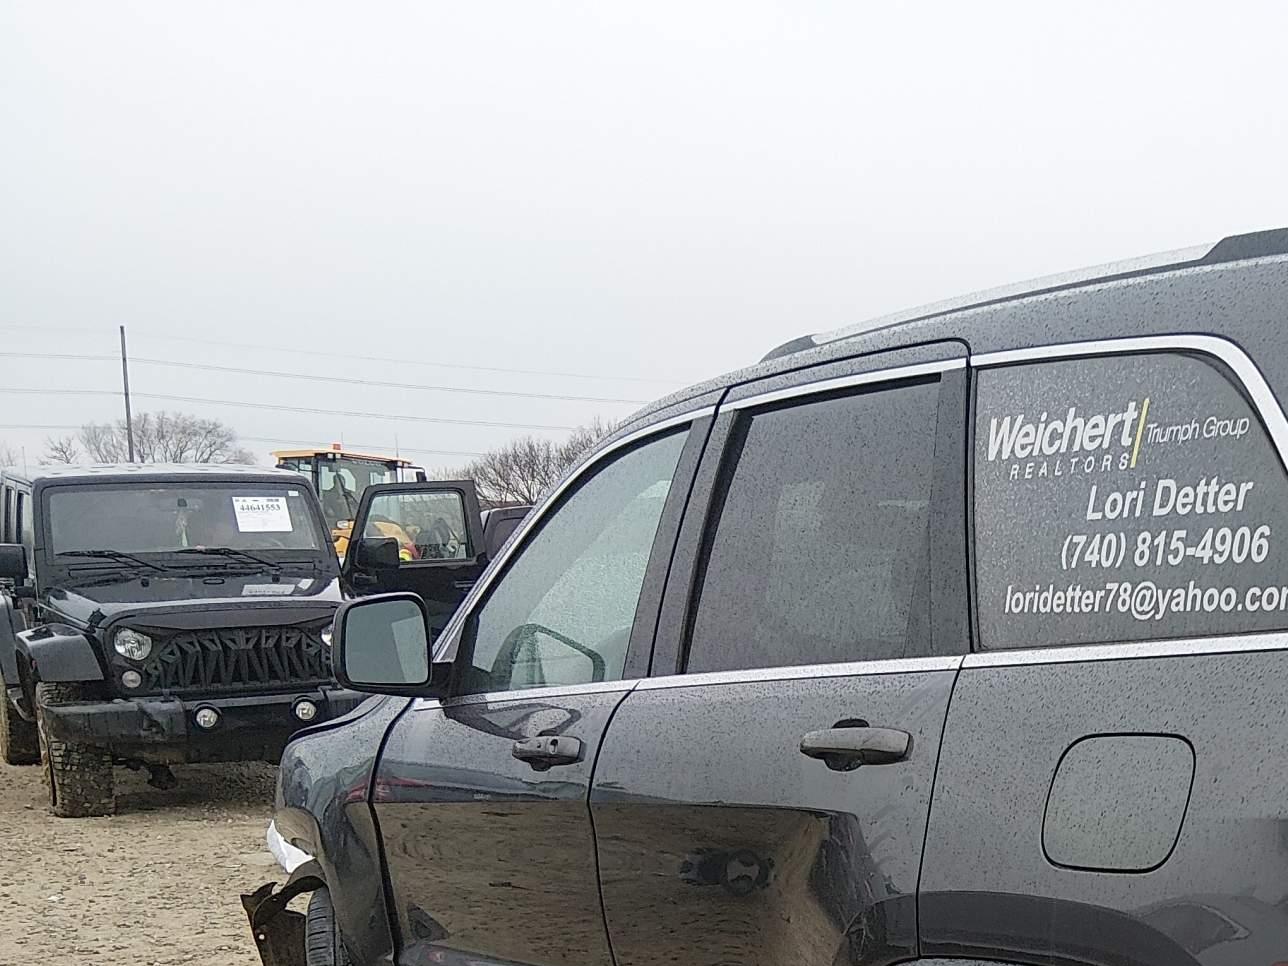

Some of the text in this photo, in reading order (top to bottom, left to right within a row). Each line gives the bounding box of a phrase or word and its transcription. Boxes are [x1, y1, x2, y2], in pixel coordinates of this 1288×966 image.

[987, 401, 1137, 461] Weichert
[1147, 416, 1249, 445] Triumph Group
[1010, 453, 1129, 480] REALTORS
[1086, 478, 1253, 520] Lori Detter
[1061, 525, 1271, 570] (740) 815-4906
